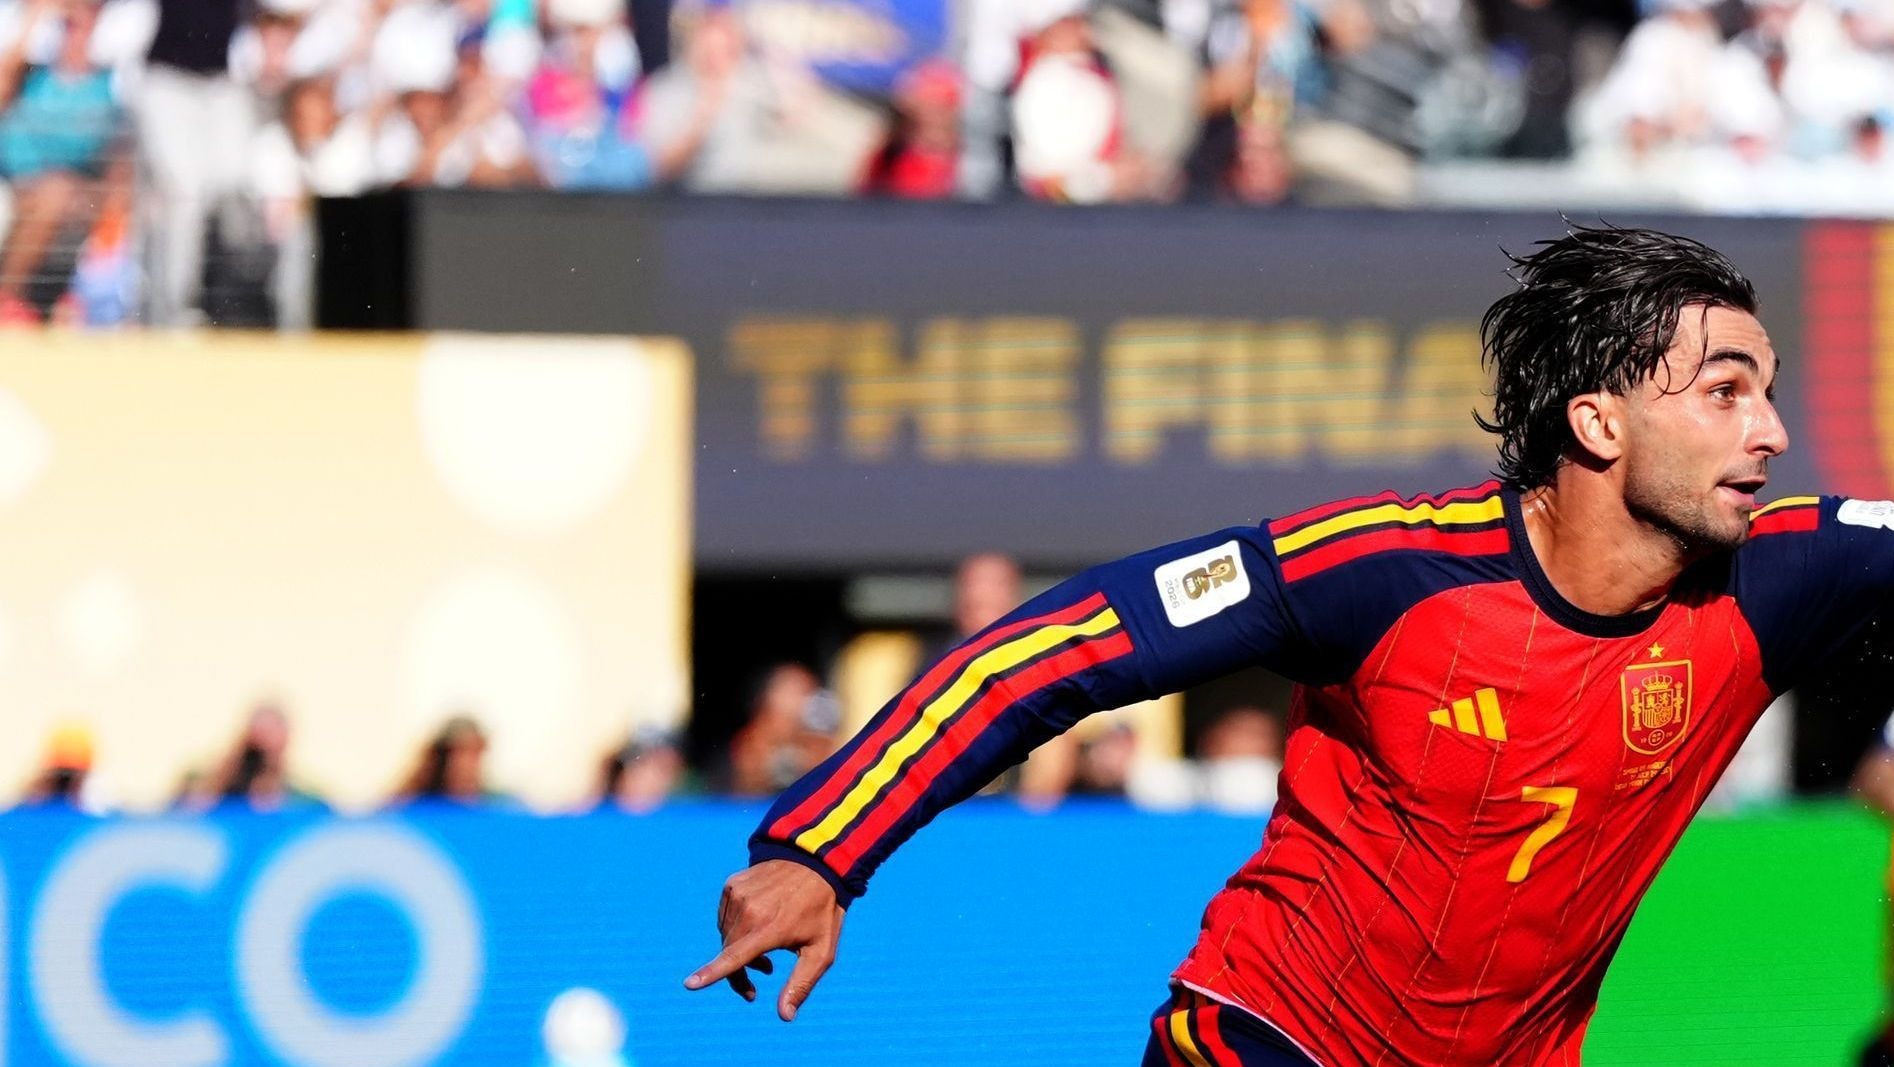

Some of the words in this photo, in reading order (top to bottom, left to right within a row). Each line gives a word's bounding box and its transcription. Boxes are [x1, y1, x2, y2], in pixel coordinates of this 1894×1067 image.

[727, 315, 1080, 464] THE
[1098, 315, 1492, 465] FINA
[1164, 578, 1181, 609] 2026
[1506, 786, 1579, 883] 7
